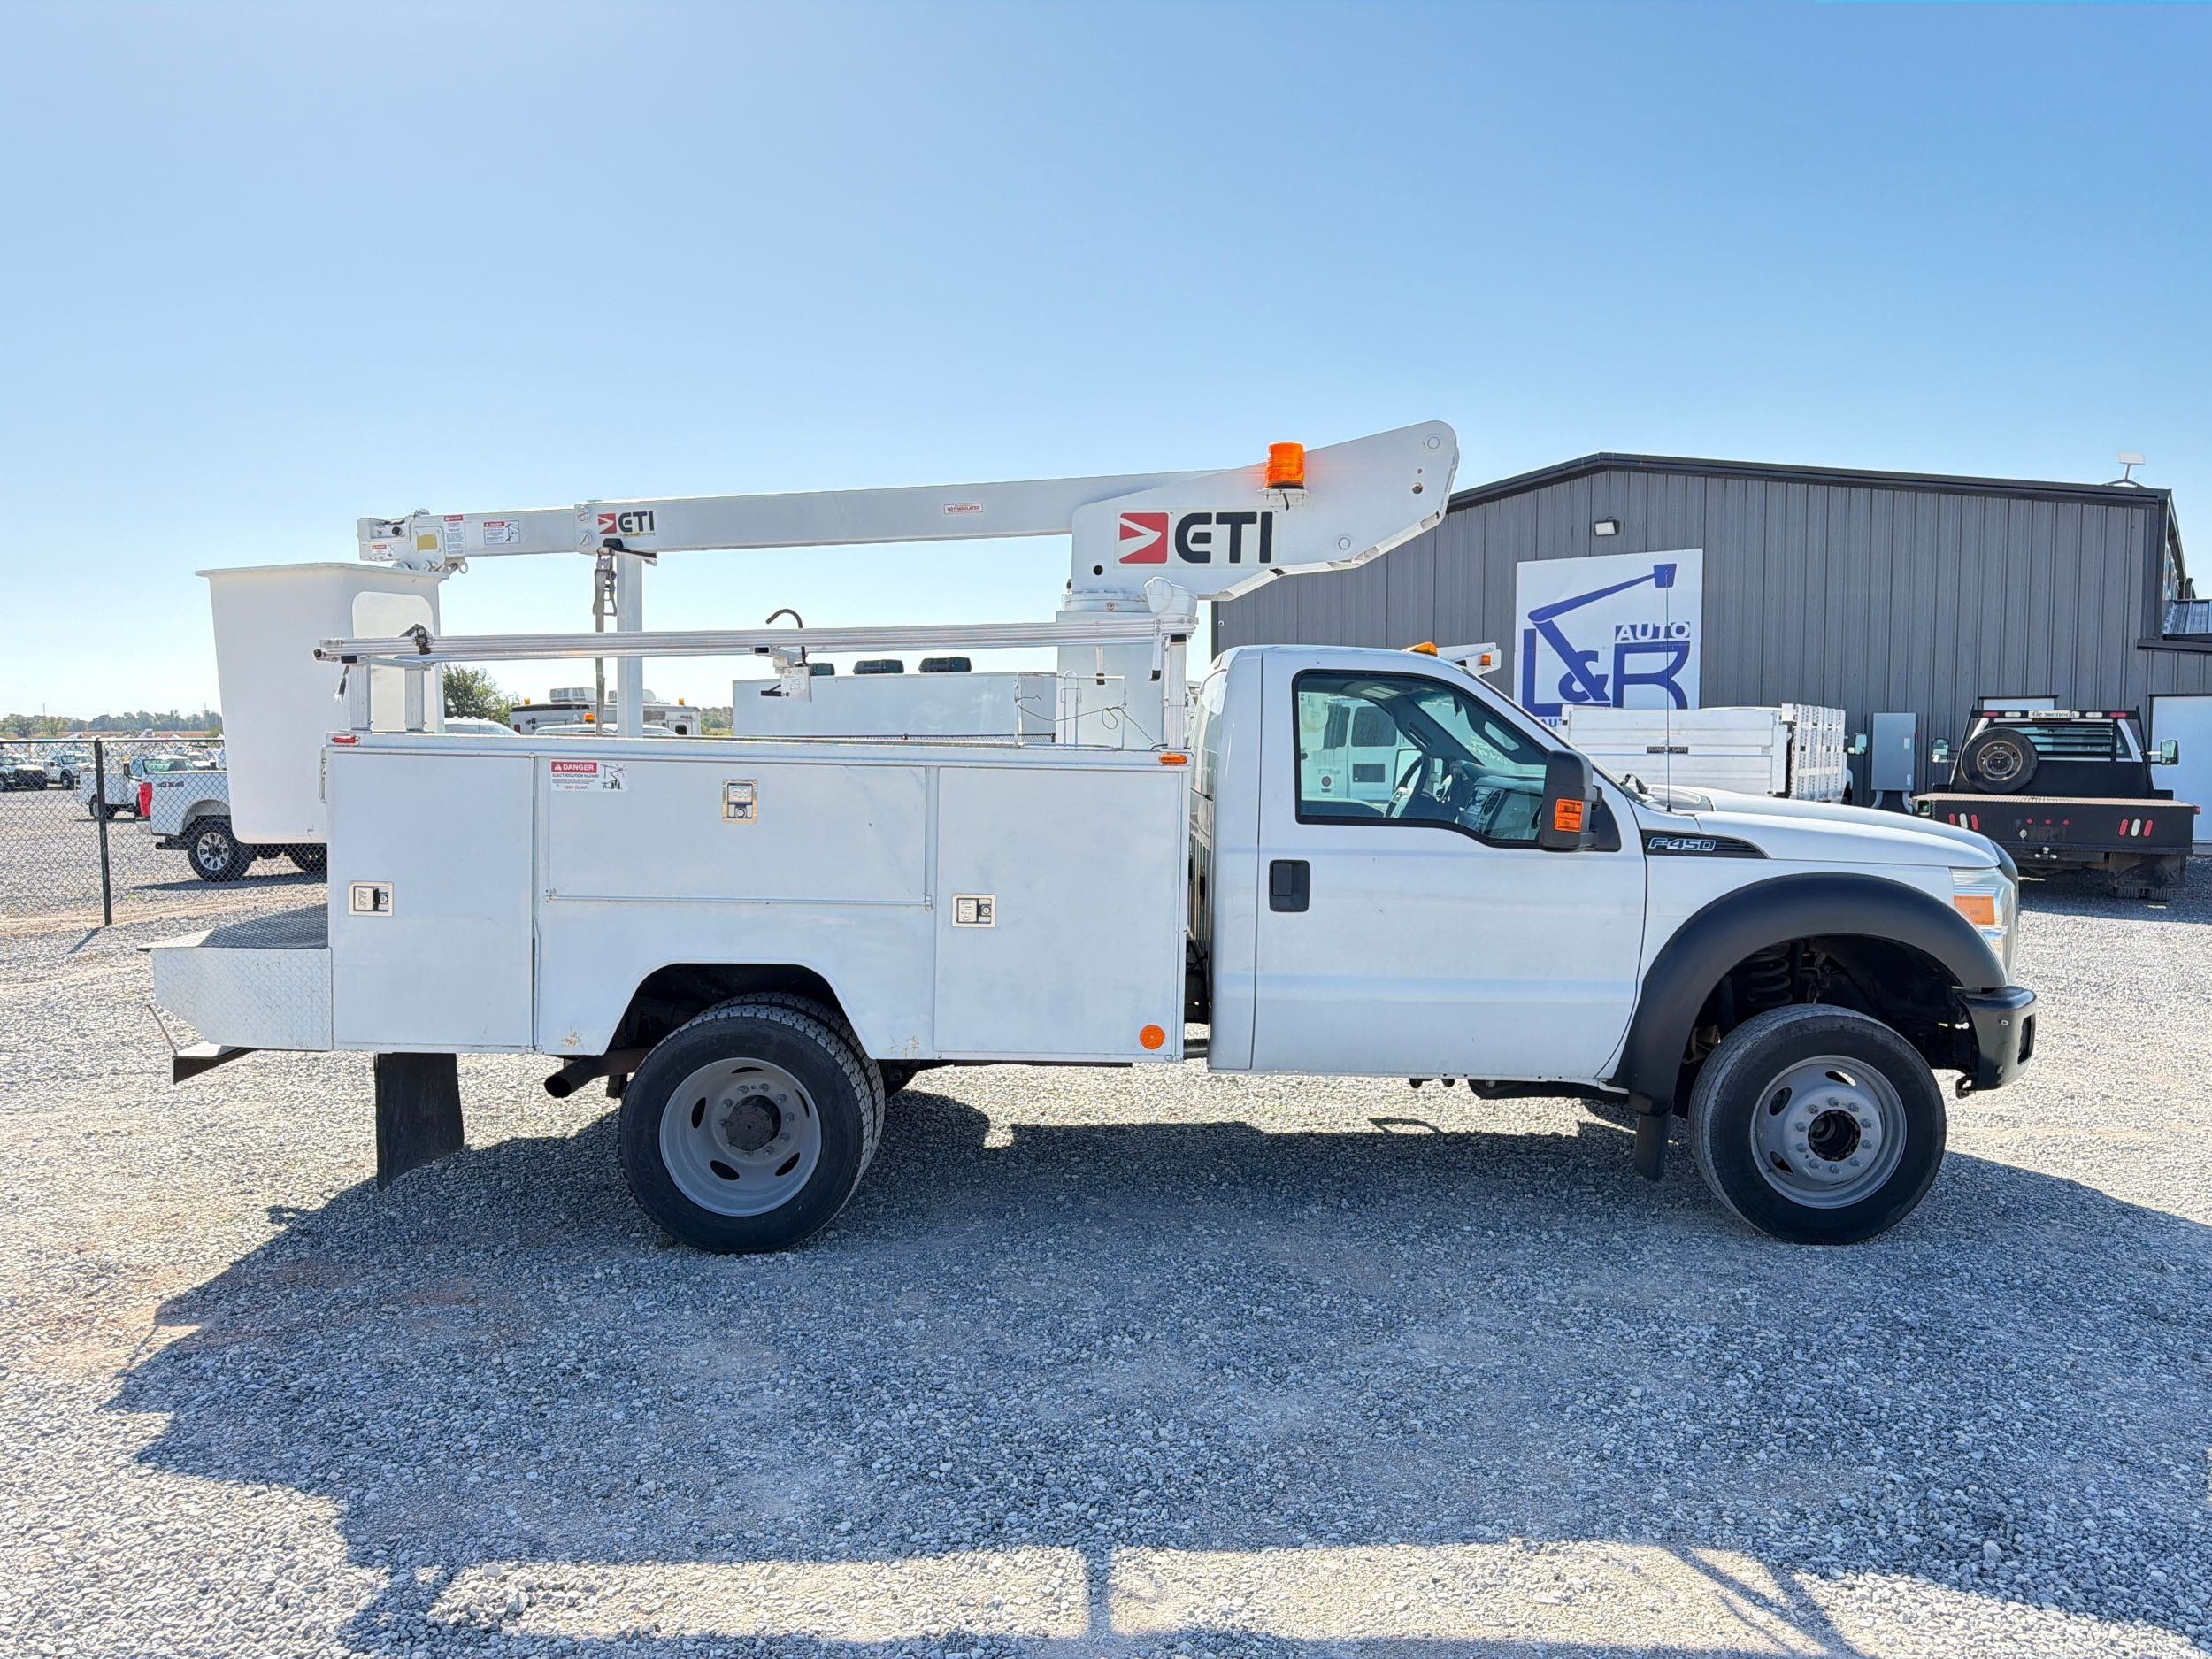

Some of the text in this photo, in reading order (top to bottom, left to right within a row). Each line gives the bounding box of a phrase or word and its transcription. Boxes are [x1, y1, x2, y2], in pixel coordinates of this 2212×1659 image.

[618, 510, 655, 533] ETI
[1174, 511, 1273, 564] ETI
[1615, 622, 1691, 641] AUTO
[1647, 837, 1716, 851] F-450
